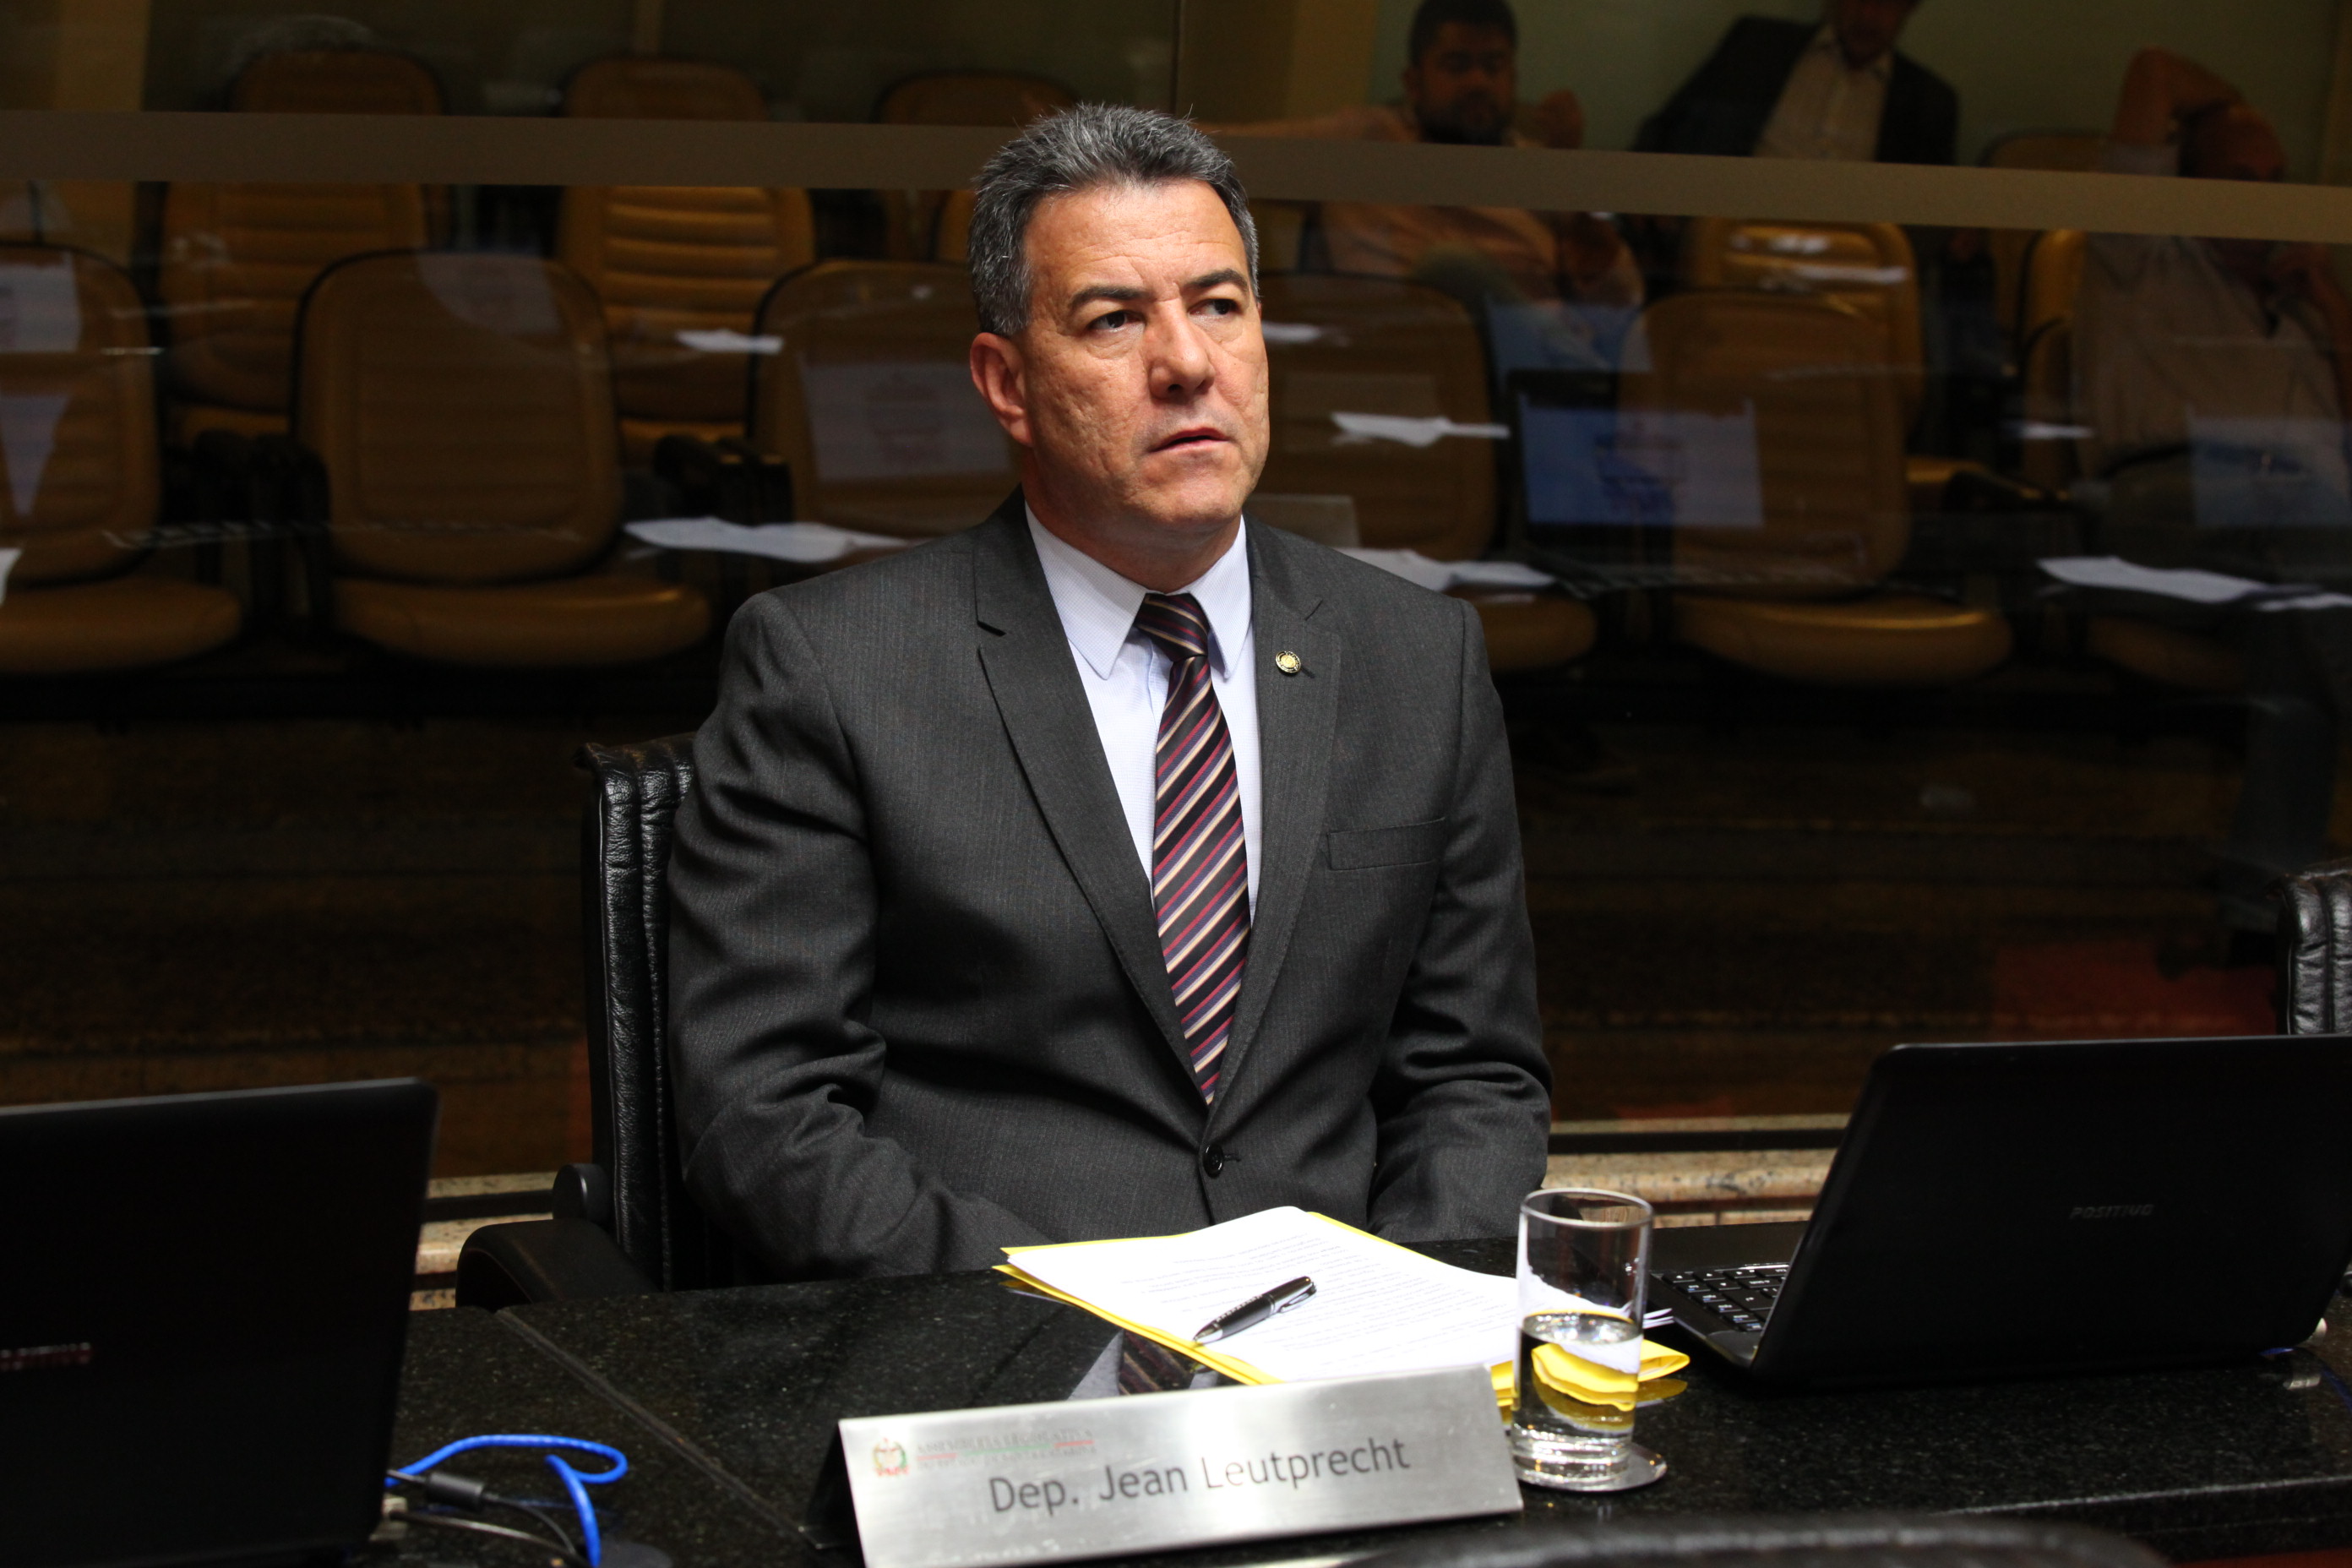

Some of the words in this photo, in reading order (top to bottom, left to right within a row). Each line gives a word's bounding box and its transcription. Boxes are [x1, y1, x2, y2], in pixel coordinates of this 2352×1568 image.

[989, 1477, 1078, 1516] Dep.
[1099, 1465, 1188, 1500] Jean
[1200, 1437, 1410, 1489] Leutprecht
